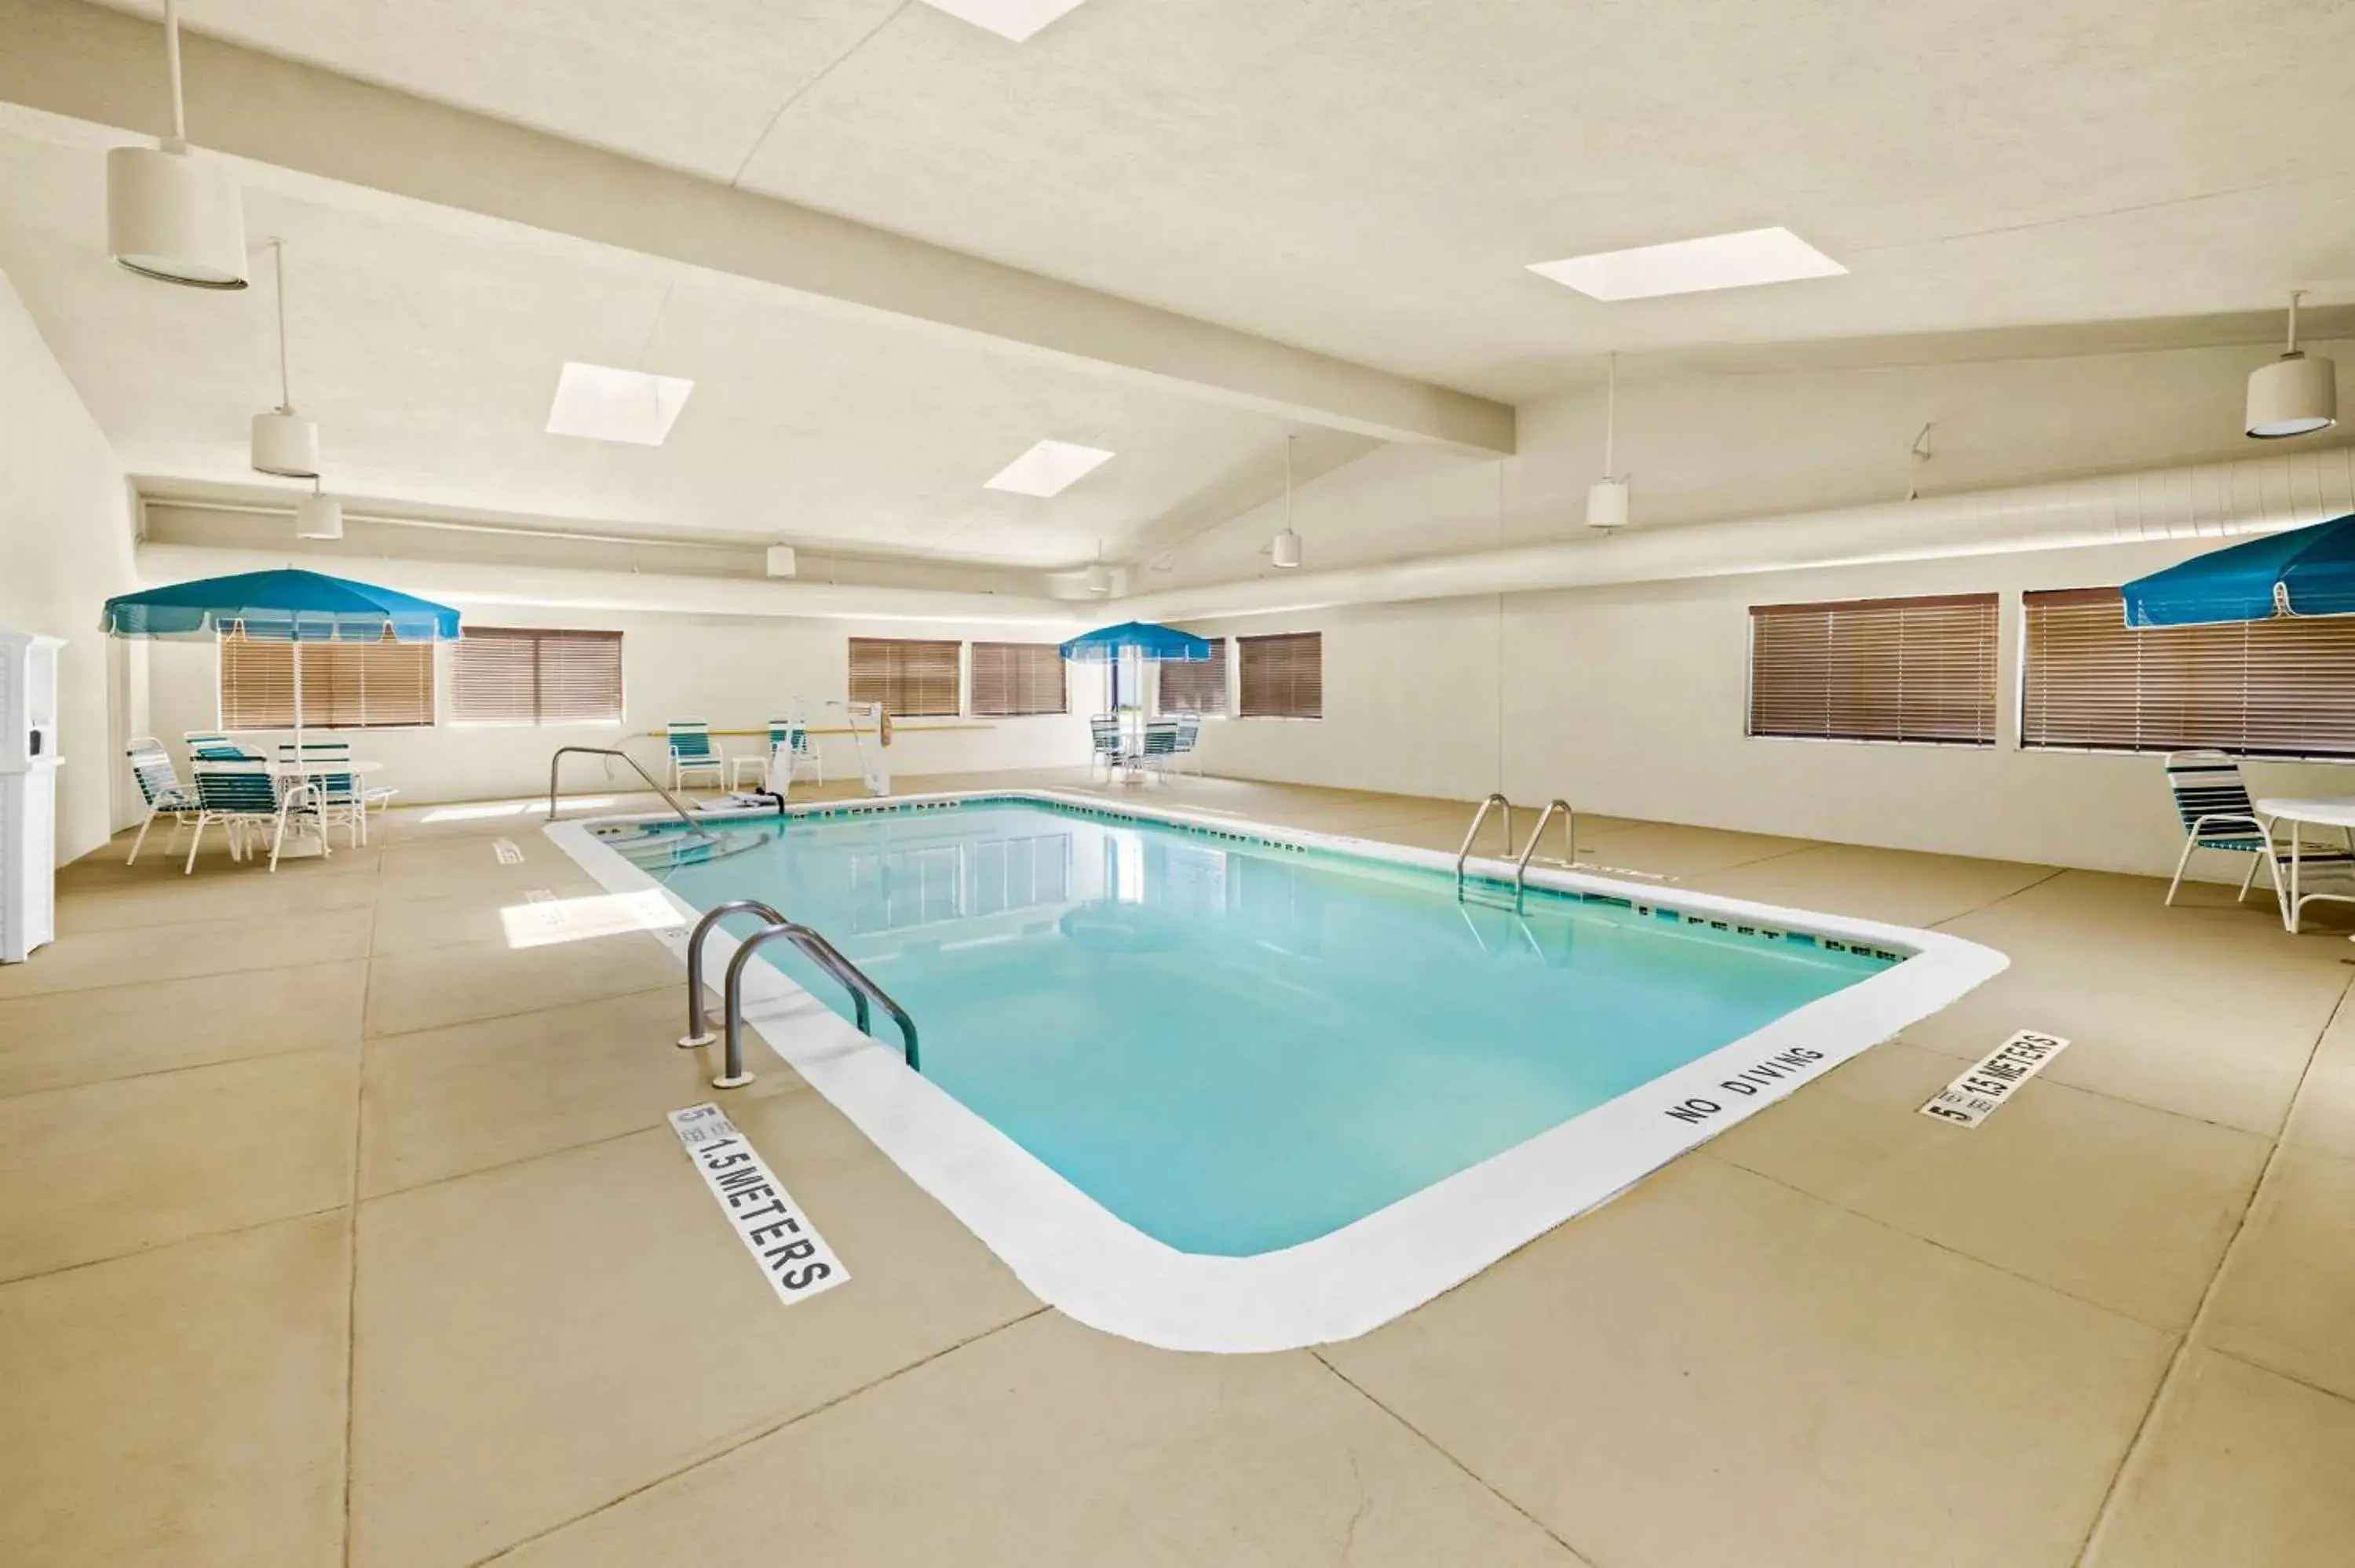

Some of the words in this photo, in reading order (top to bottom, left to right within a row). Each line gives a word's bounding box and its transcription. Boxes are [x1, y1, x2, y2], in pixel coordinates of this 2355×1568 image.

[677, 1107, 717, 1122] 5
[1664, 1099, 1722, 1125] NO
[1719, 1048, 1824, 1096] DIVING
[1929, 1106, 1972, 1121] 5
[1977, 1035, 2059, 1081] METERS
[699, 1139, 751, 1169] 1.5
[715, 1166, 831, 1290] METERS
